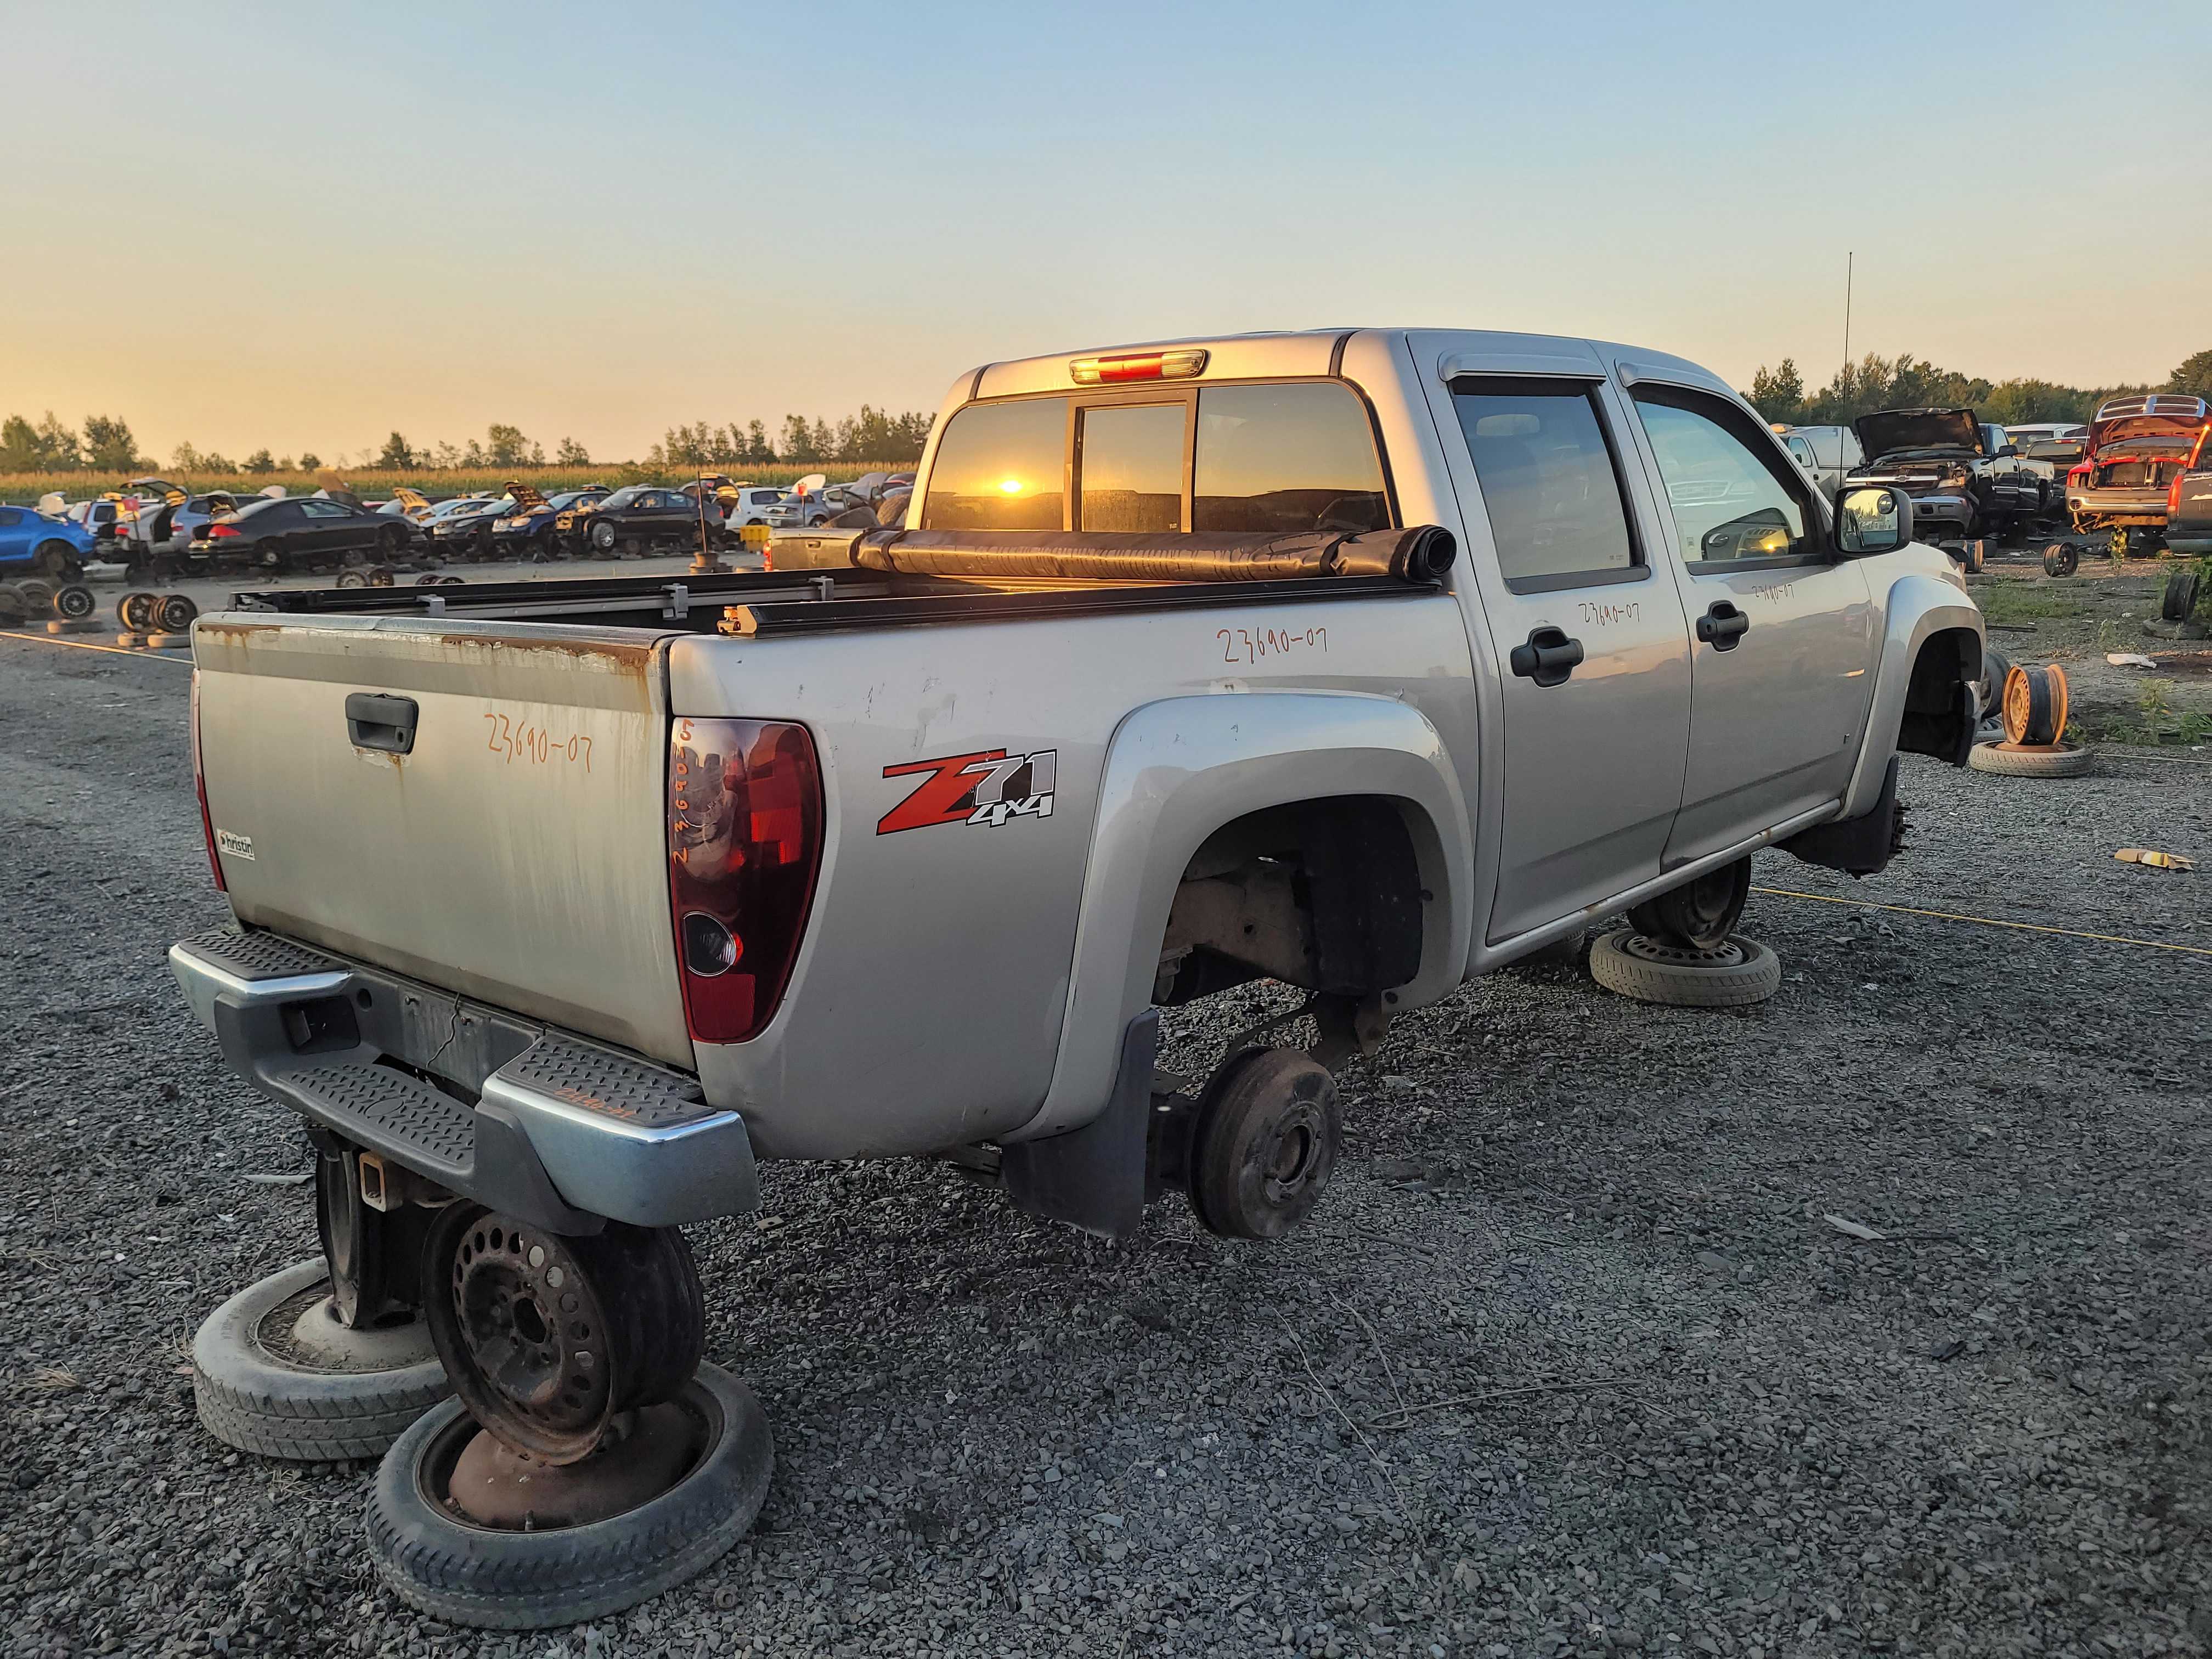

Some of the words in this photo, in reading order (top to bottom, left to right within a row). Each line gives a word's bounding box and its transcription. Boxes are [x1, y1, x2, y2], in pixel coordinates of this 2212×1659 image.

[1578, 602, 1640, 626] 23690-07
[1752, 584, 1795, 605] 23690-07
[1217, 627, 1328, 664] 23690-07
[484, 714, 592, 773] 23690-07
[673, 718, 696, 865] 23690-07
[876, 748, 1057, 836] Z71
